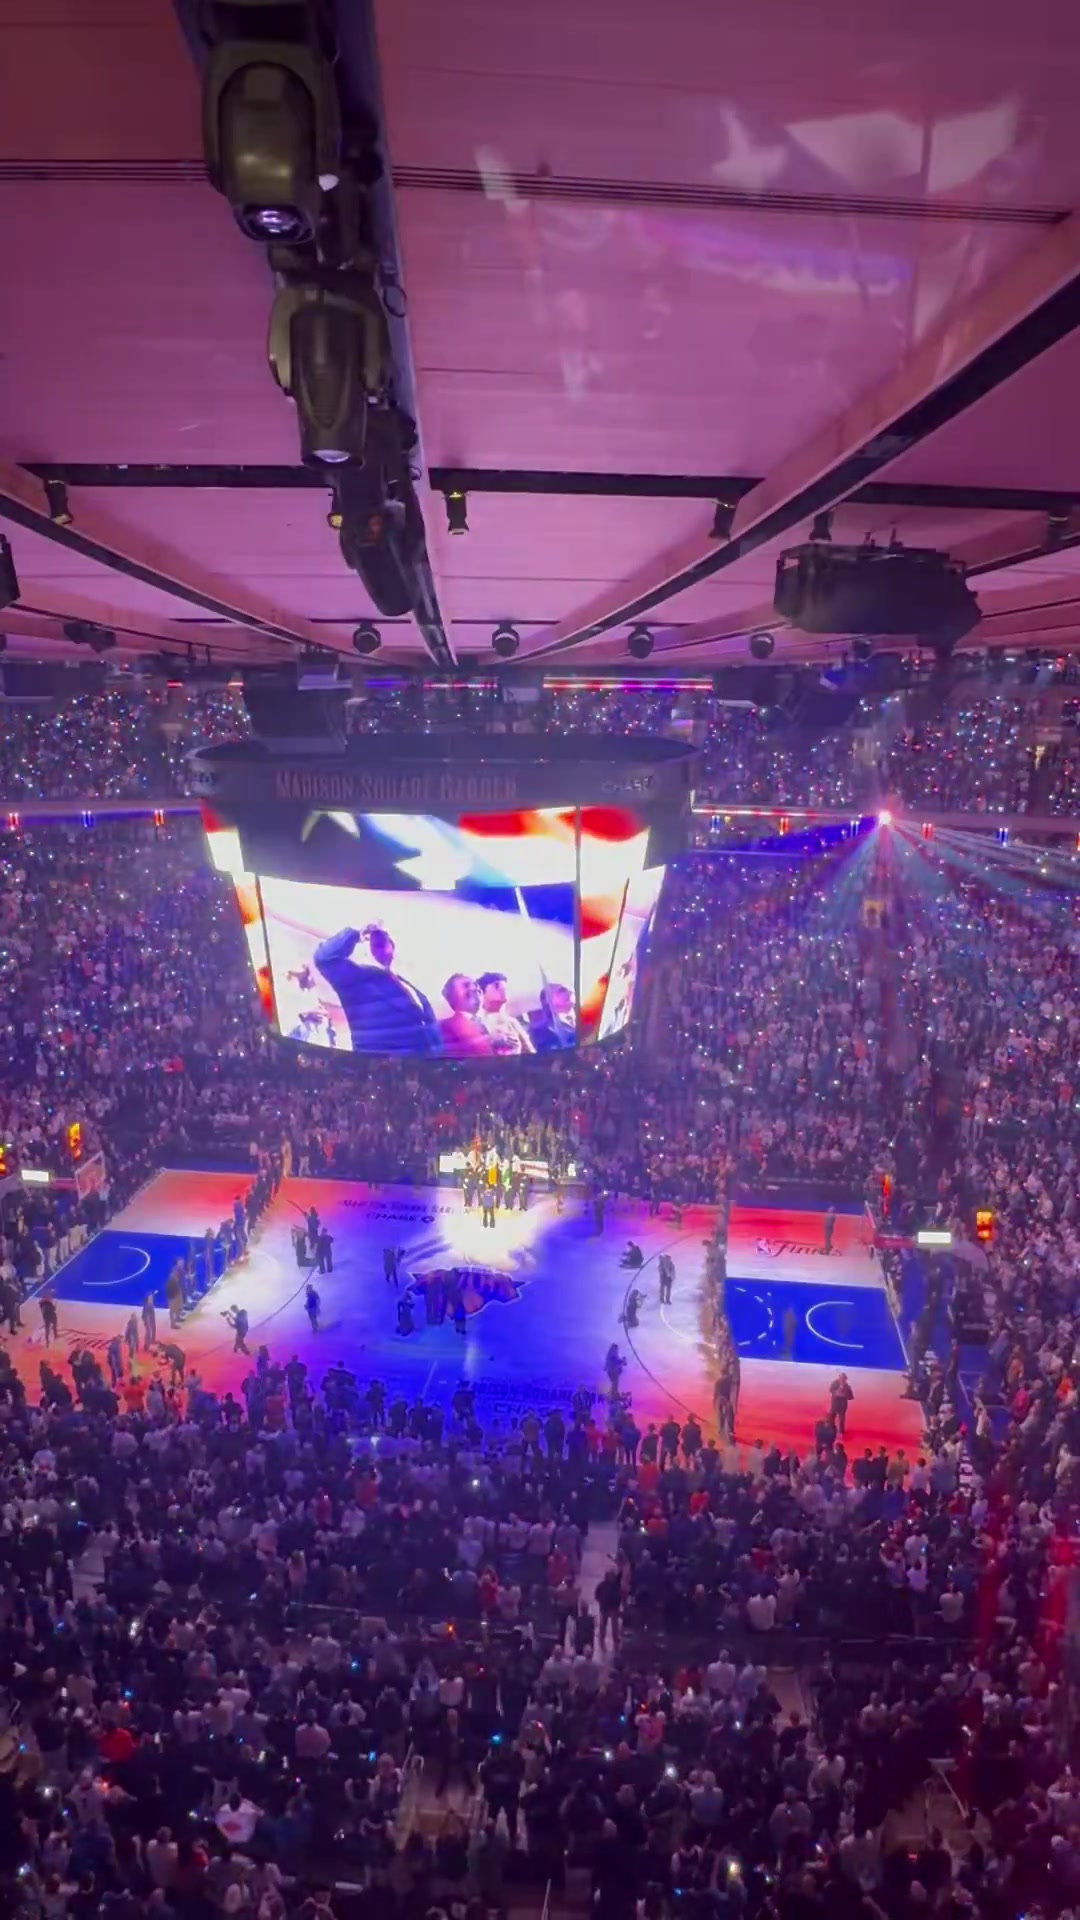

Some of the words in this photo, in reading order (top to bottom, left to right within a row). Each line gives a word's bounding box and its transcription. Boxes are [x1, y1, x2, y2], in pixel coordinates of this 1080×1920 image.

[275, 769, 354, 800] MADISON
[360, 771, 429, 801] SQUARE
[440, 773, 518, 801] GARDEN
